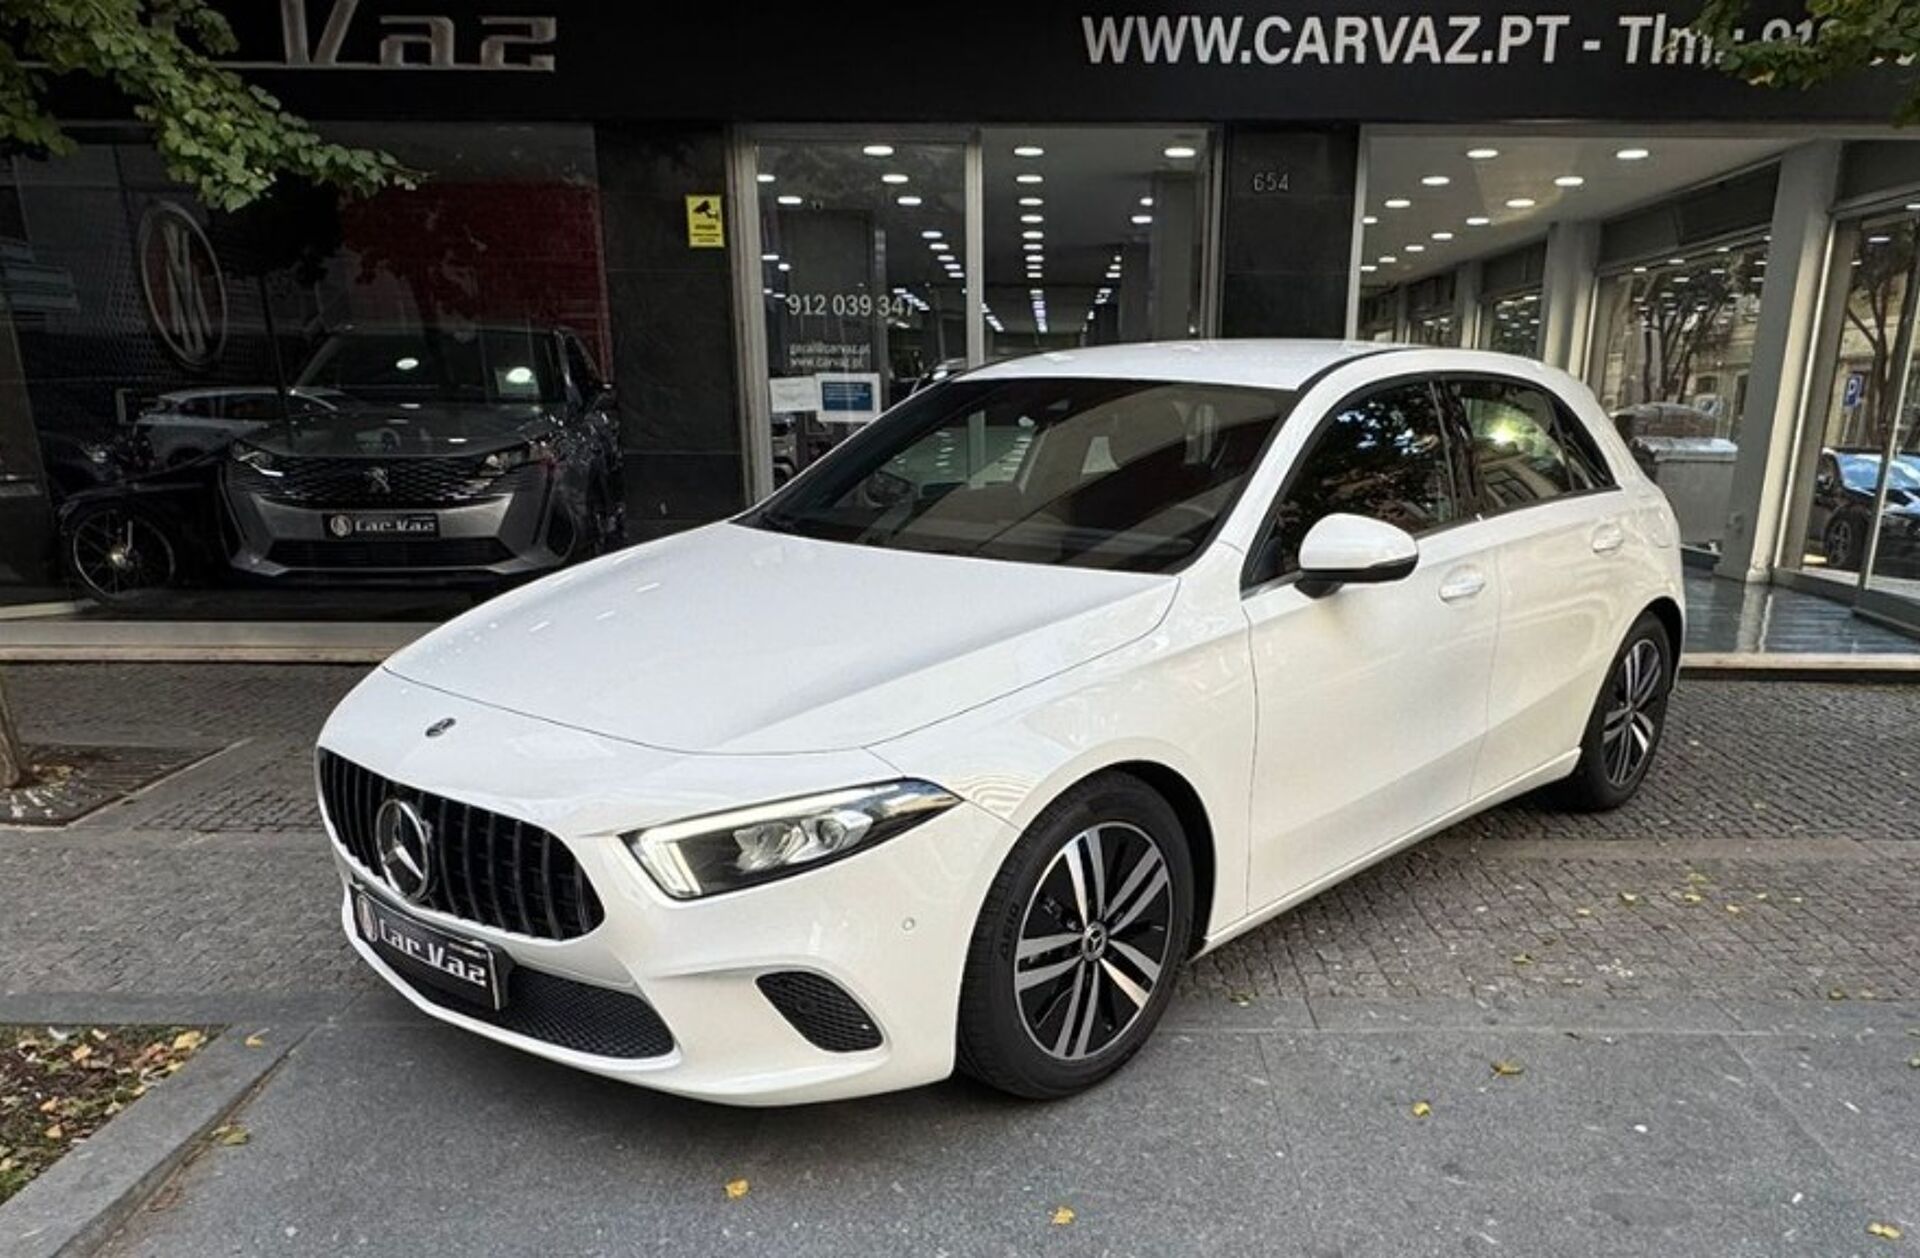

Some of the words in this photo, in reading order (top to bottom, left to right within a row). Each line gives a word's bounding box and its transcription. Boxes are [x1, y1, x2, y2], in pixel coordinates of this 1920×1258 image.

[1082, 16, 1570, 64] WWW.CARVAZ.PT
[1254, 172, 1289, 191] 654
[788, 294, 827, 316] 912
[832, 294, 872, 316] 039
